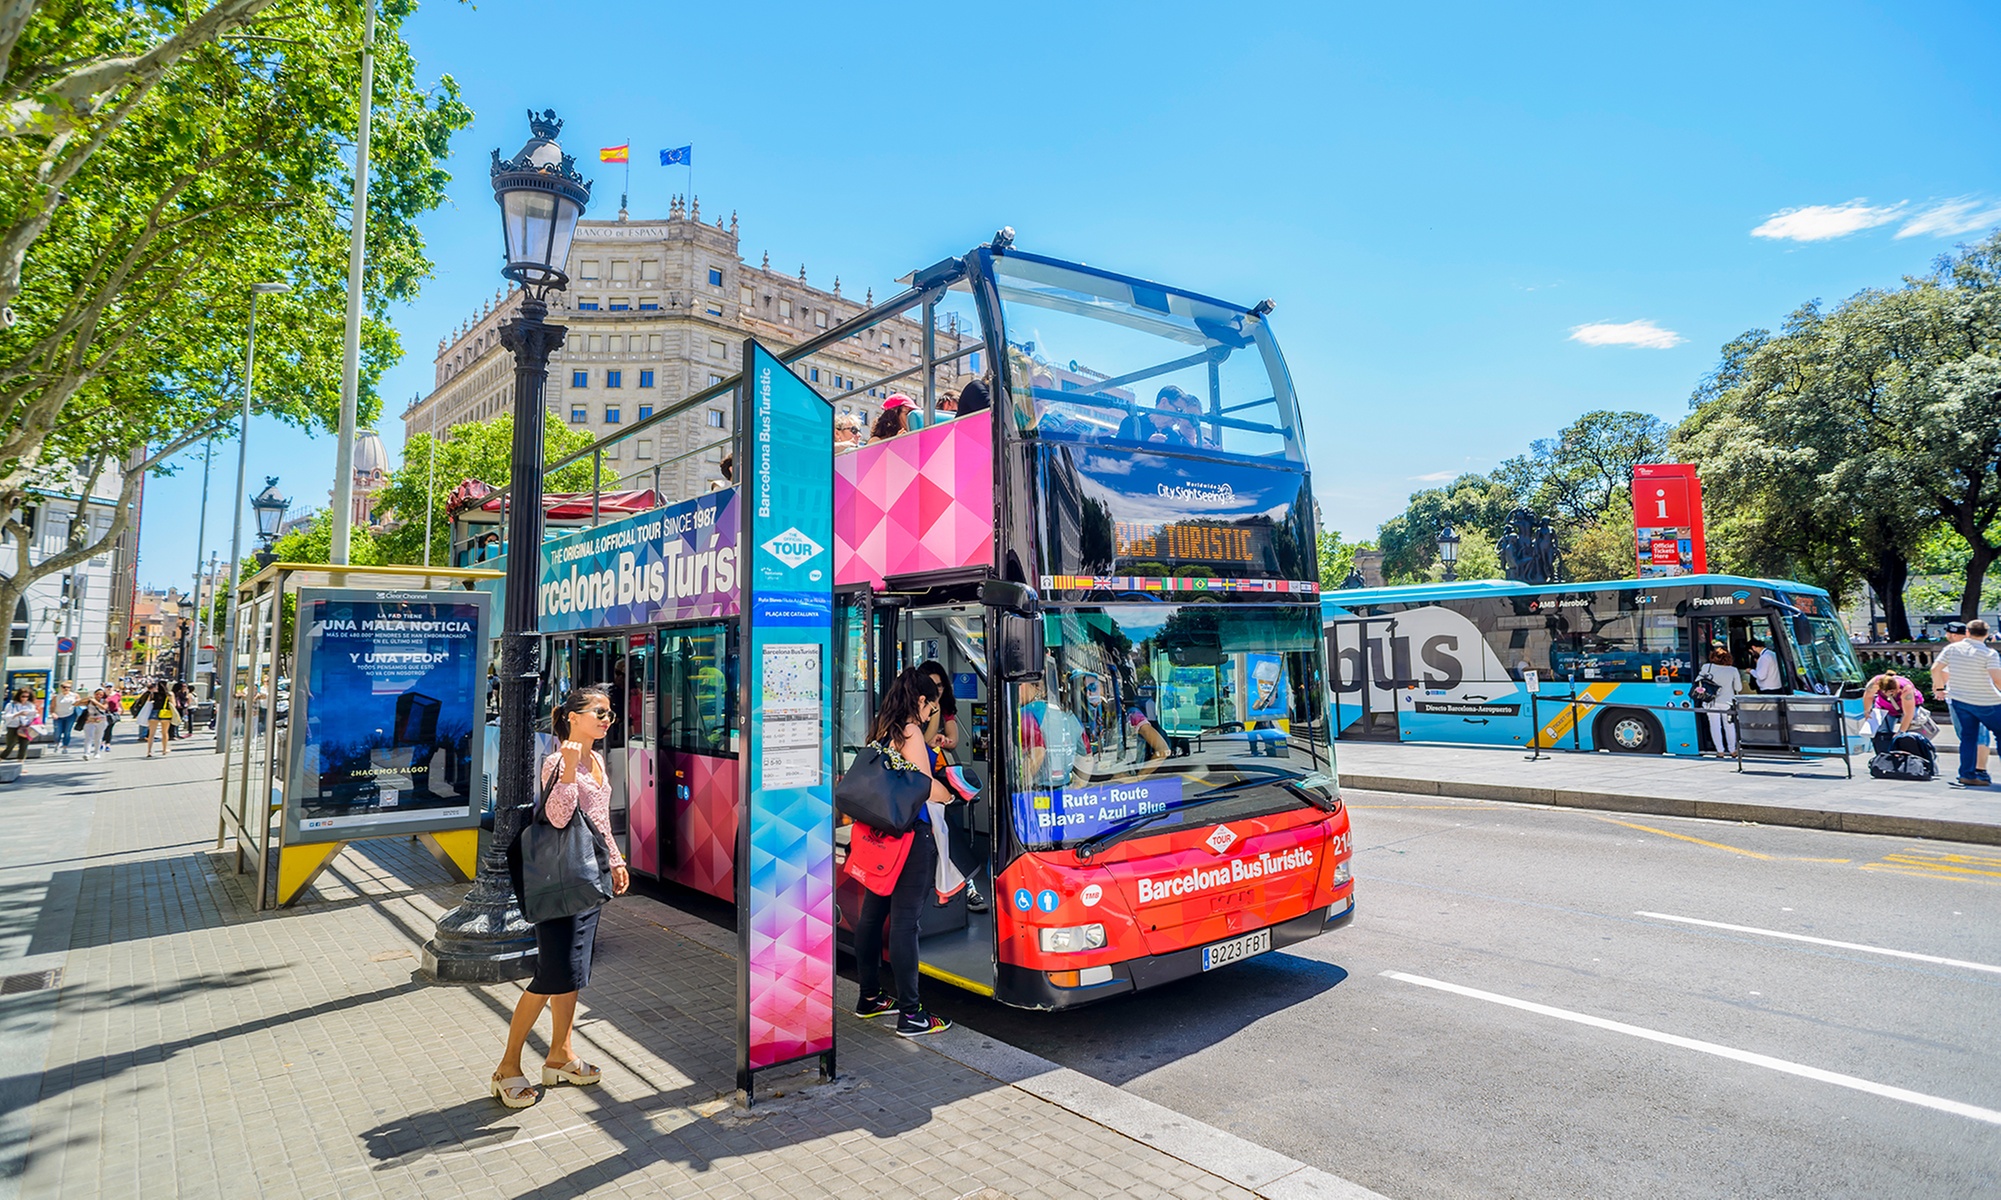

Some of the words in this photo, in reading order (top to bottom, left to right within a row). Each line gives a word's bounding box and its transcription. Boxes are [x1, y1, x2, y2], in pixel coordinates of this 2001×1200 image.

[576, 228, 612, 236] BANCO
[628, 228, 664, 236] ESPAÑA
[759, 368, 770, 442] BusTurístic
[758, 445, 770, 518] Barcelona
[1157, 483, 1175, 499] City
[1176, 486, 1224, 505] Sightseeing
[1655, 489, 1669, 518] i
[551, 550, 563, 565] THE
[563, 542, 594, 563] ORIGINAL
[595, 542, 600, 554] &
[600, 531, 636, 552] OFFICIAL
[636, 521, 661, 542] TOUR
[664, 512, 692, 536] SINCE
[693, 506, 716, 529] 1987
[1115, 522, 1156, 557] BUS
[1165, 525, 1253, 560] TURISTIC
[772, 542, 812, 556] TOUR
[538, 564, 614, 617] rcelona
[1693, 598, 1714, 606] Free
[1714, 596, 1733, 605] Wifi
[1559, 599, 1589, 608] Aerobús
[322, 620, 357, 630] UNA
[362, 620, 406, 631] MALA
[410, 622, 471, 632] NOTICIA
[350, 653, 361, 663] Y
[365, 653, 397, 663] UNA
[1448, 705, 1512, 714] Barcelona-Aeropuerto
[351, 768, 398, 776] ¿HACEMOS
[401, 766, 428, 774] ALGO?
[1062, 790, 1098, 808] Ruta
[1110, 786, 1149, 802] Route
[1038, 808, 1085, 828] Blava
[1098, 804, 1126, 820] Azul
[1138, 800, 1166, 816] Blue
[1212, 834, 1231, 845] TOUR
[1138, 865, 1230, 903] Barcelona
[1232, 847, 1313, 882] BusTurístic
[1085, 892, 1100, 900] TMB
[1212, 942, 1242, 965] 9223
[1245, 932, 1268, 955] FBT
